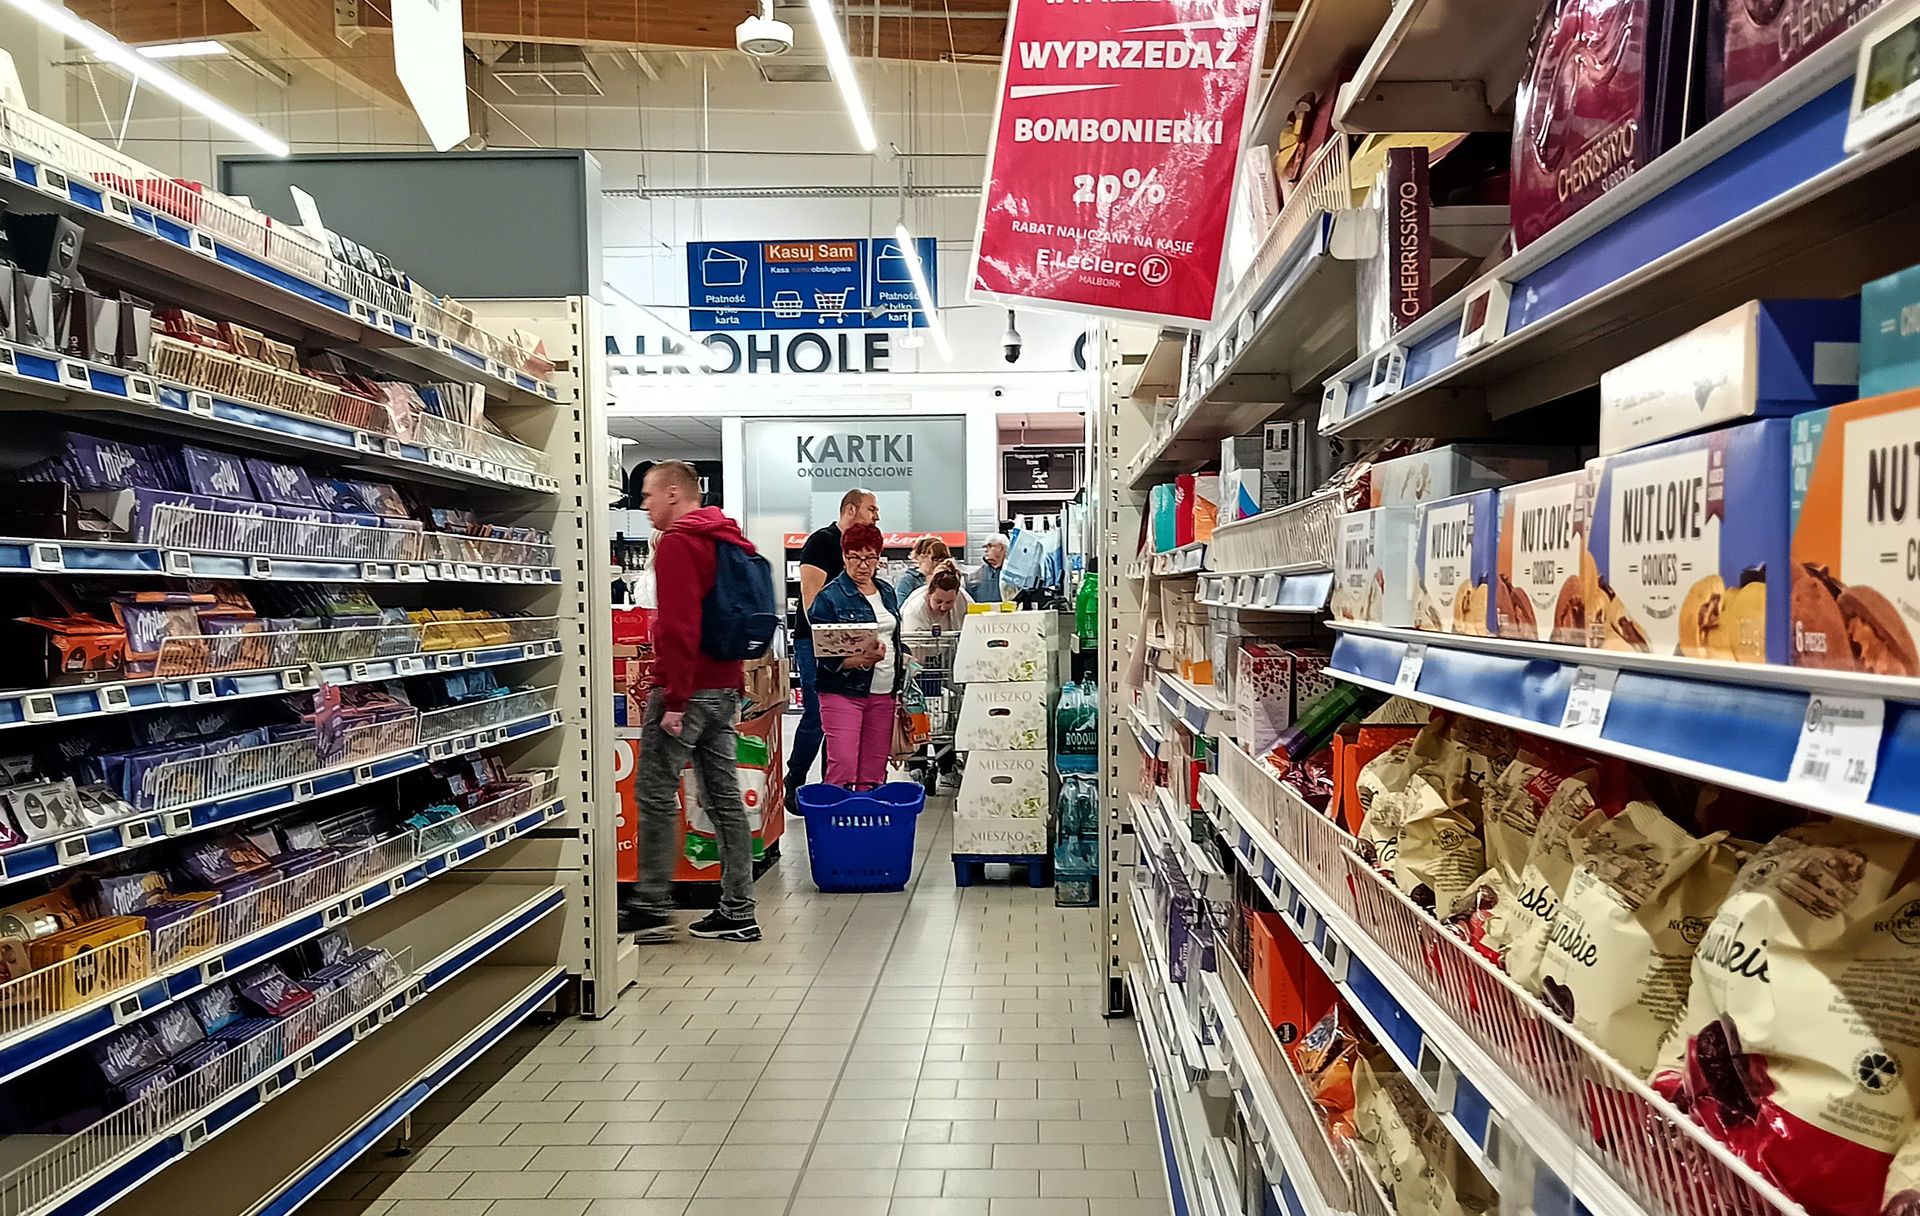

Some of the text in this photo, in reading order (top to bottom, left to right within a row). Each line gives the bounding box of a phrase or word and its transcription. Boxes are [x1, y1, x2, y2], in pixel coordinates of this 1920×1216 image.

[1014, 118, 1223, 145] BOMBONIERKI
[1073, 168, 1167, 204] 20%
[1011, 220, 1194, 254] RABAT NALICZANY NA KASIE
[769, 244, 854, 261] Kasuj Sam
[1078, 274, 1121, 288] MALBORK
[705, 294, 746, 304] Płatność
[715, 315, 740, 325] karta
[797, 434, 913, 463] KARTKI
[797, 465, 913, 478] OKOLICZNOŚCIOWE
[1622, 477, 1703, 544] NUTLOVE
[1520, 503, 1572, 553] NUTLOVE
[1431, 519, 1466, 560] NUTLOVE
[1532, 560, 1555, 585] COOKIES
[1641, 553, 1678, 586] COOKIES
[975, 622, 1031, 634] MIESZKO
[977, 691, 1032, 703] MIESZKO
[979, 759, 1034, 771] MIESZKO
[971, 831, 1024, 842] MIESZKO
